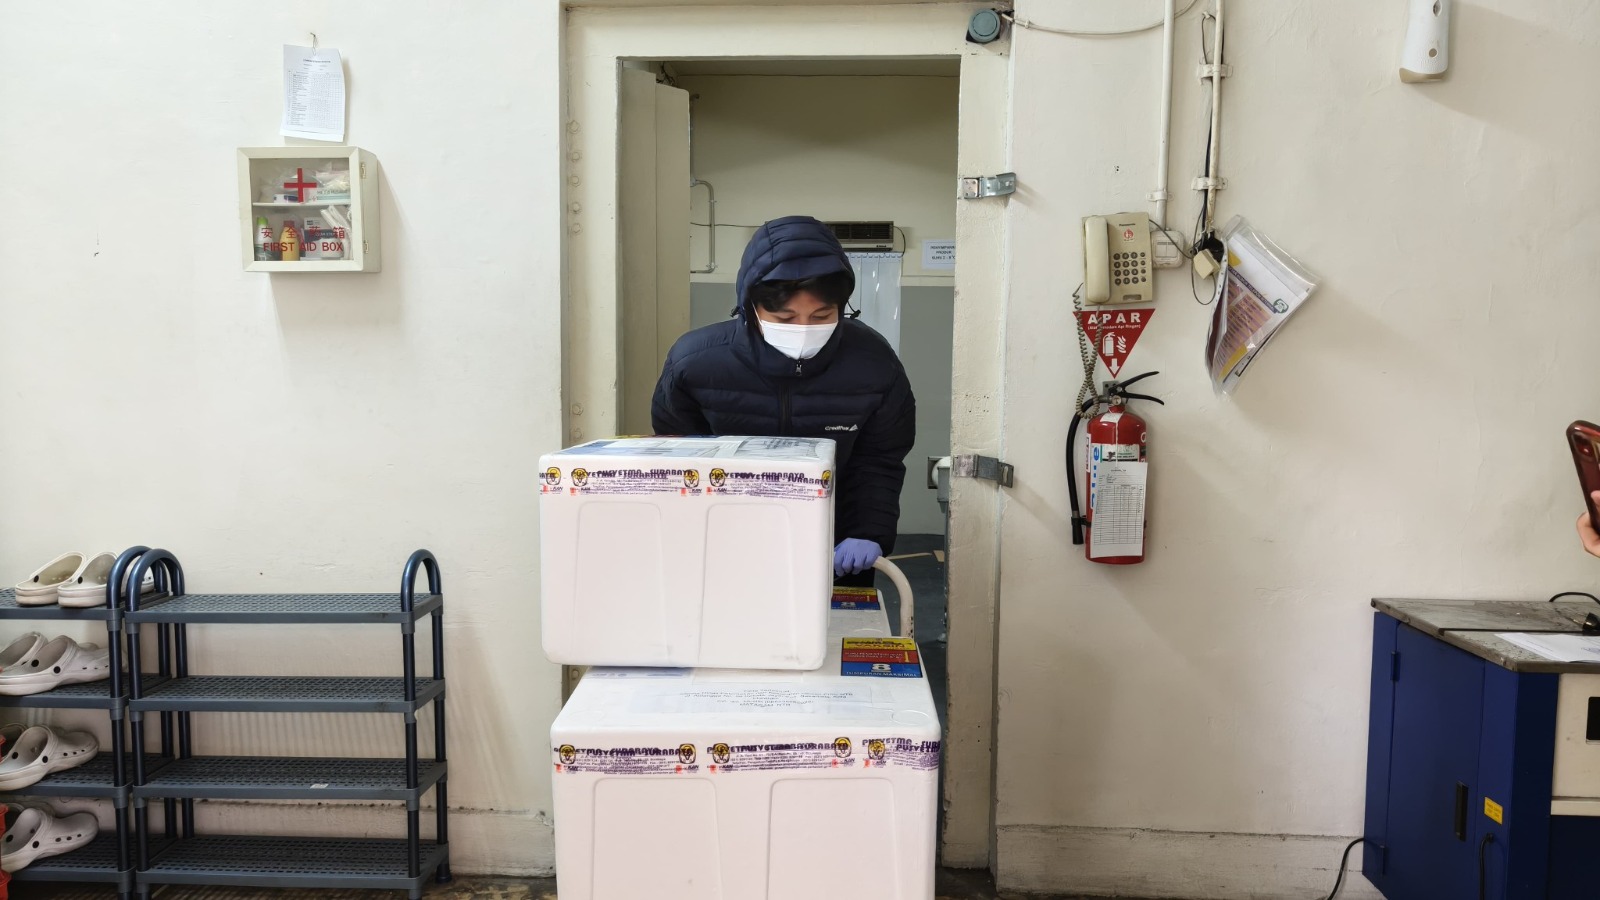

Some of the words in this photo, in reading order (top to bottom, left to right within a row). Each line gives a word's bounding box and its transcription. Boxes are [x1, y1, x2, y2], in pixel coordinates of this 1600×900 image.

[263, 242, 295, 252] FIRST
[300, 242, 317, 252] AID
[322, 242, 344, 252] BOX
[1087, 312, 1141, 324] APAR
[871, 663, 891, 672] 8
